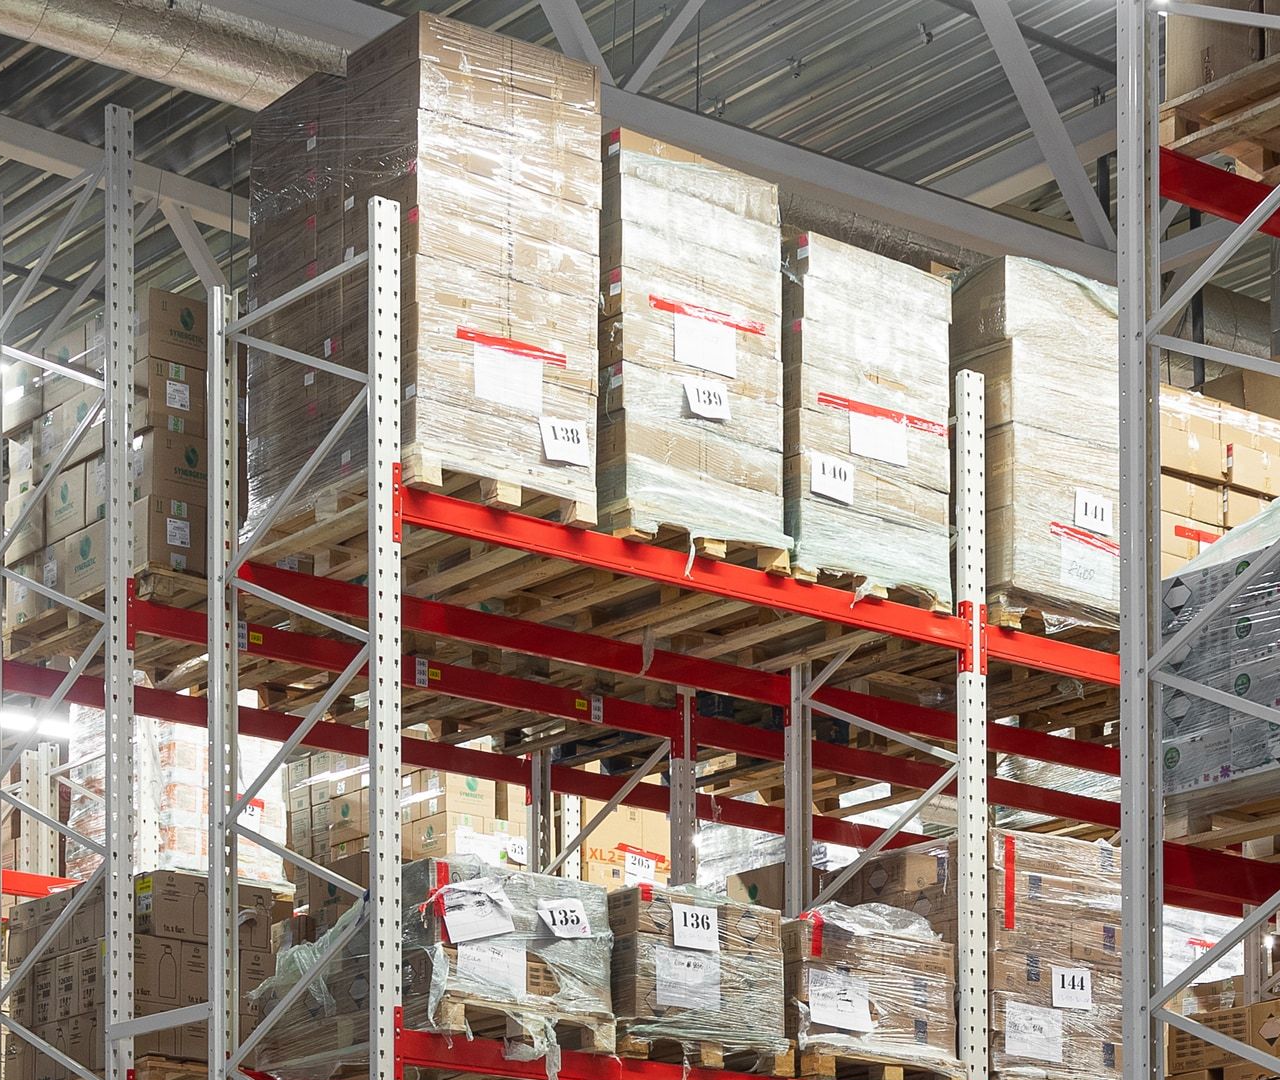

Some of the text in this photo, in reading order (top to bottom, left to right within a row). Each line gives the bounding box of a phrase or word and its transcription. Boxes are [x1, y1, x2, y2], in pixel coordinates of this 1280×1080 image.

[170, 329, 204, 345] SYNERGETIC
[695, 387, 722, 407] 139
[551, 424, 581, 445] 138
[820, 461, 847, 483] 140
[1082, 501, 1105, 521] 141
[589, 848, 616, 863] XL2
[631, 854, 650, 870] 205
[547, 909, 581, 927] 135
[682, 912, 711, 931] 136
[1060, 973, 1086, 991] 144
